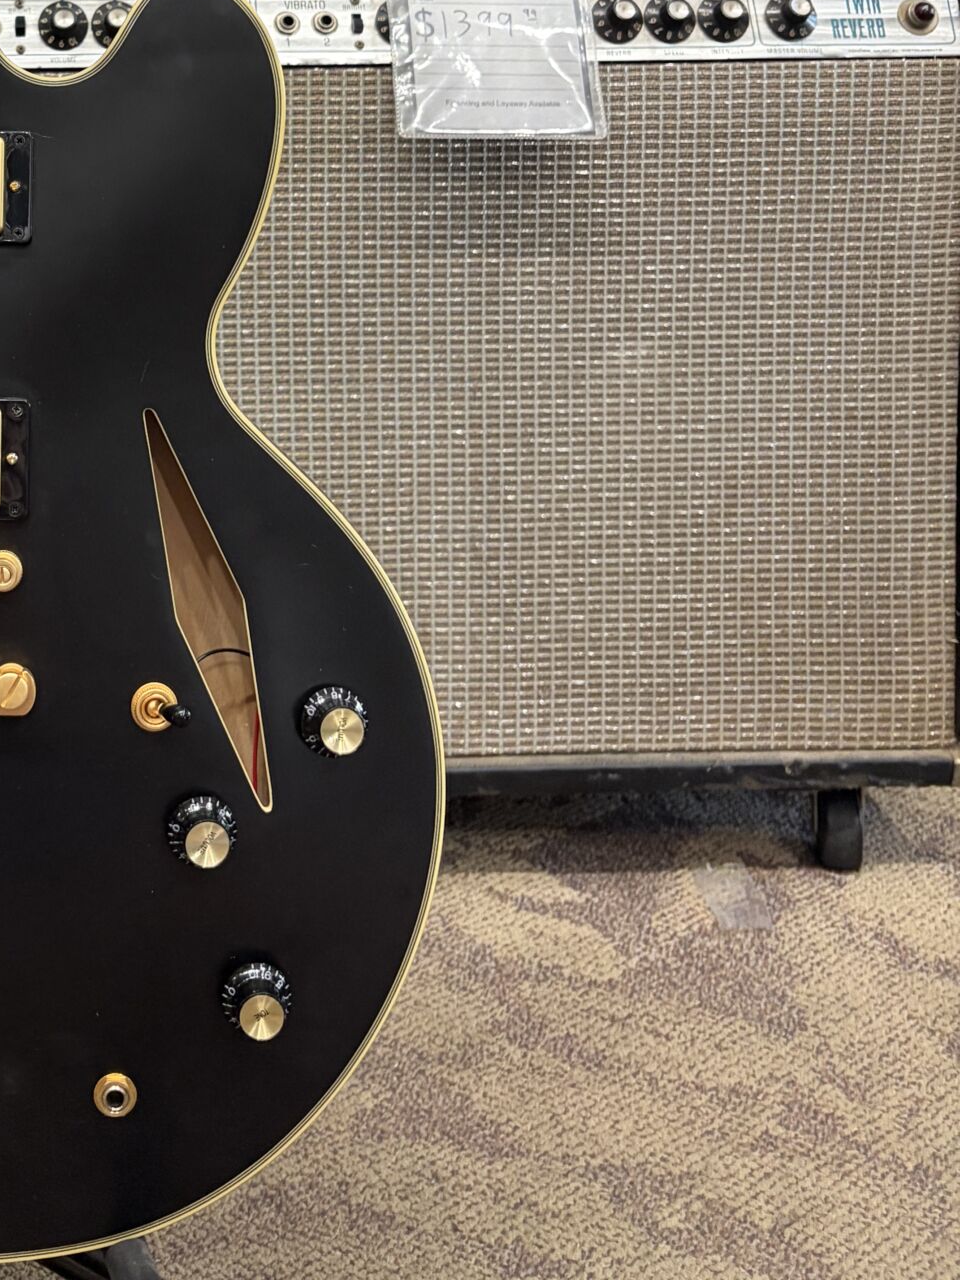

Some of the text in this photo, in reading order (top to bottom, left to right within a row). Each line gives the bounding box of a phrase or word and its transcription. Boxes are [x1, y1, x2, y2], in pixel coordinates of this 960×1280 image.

[284, 0, 326, 10] VIBRATO
[414, 7, 537, 42] $1399 99
[831, 18, 886, 39] REVERB
[481, 99, 495, 107] and
